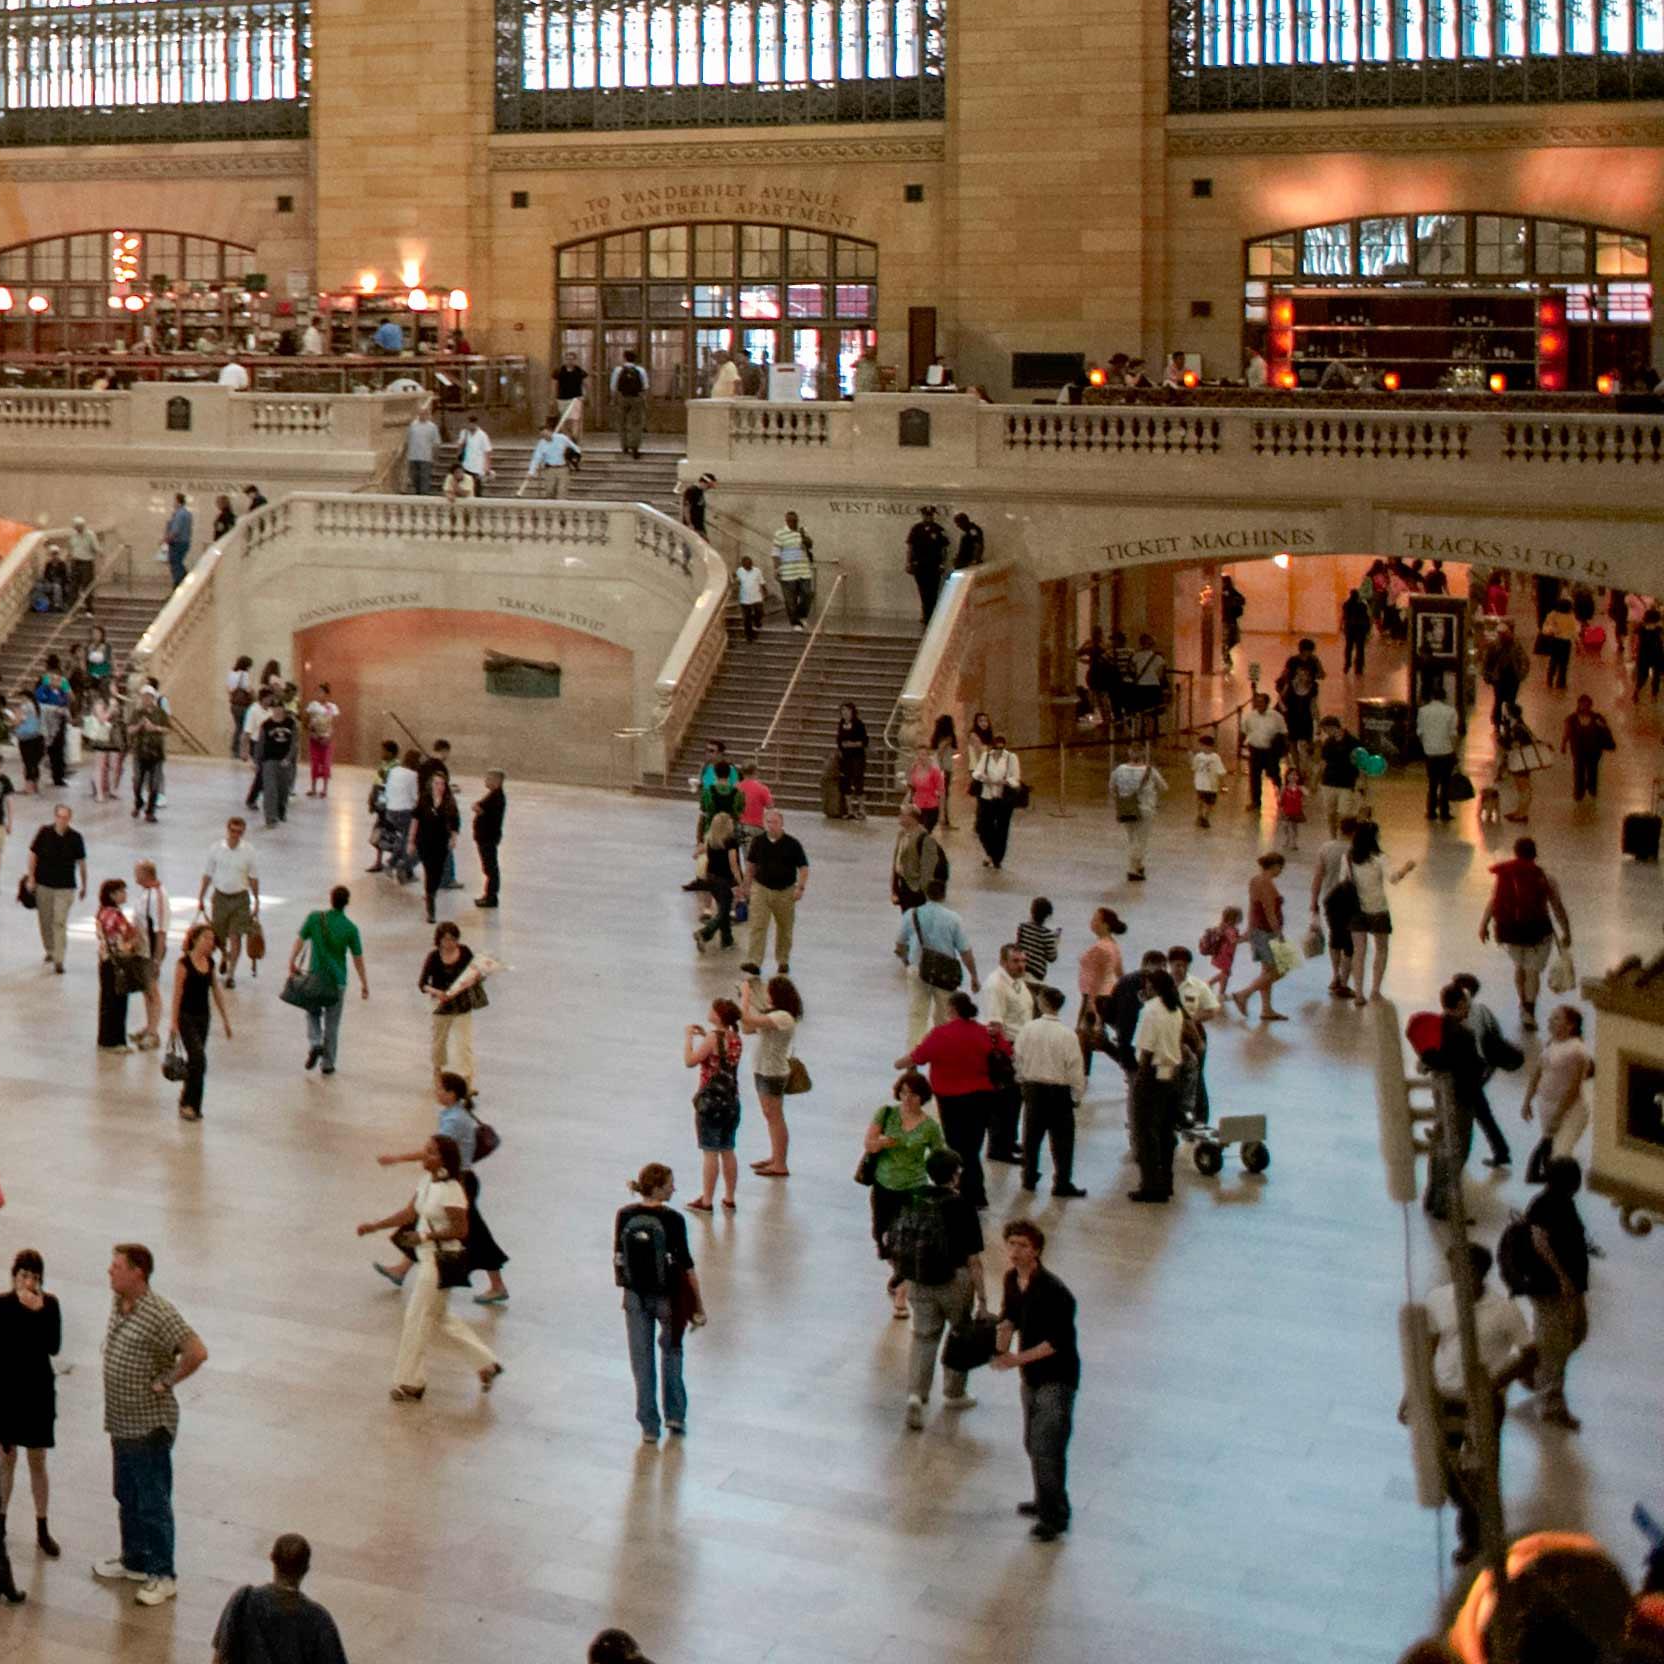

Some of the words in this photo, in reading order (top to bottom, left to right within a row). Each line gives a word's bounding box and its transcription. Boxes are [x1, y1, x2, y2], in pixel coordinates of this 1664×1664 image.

[586, 196, 610, 212] TO
[622, 184, 747, 204] VANDERBILT
[762, 186, 842, 208] AVENUE
[572, 215, 610, 233] THE
[621, 201, 722, 221] CAMPBELL
[736, 203, 857, 229] APARTMENT
[829, 501, 872, 514] WEST
[1100, 536, 1184, 561] TICKET
[1189, 527, 1316, 551] MACHINES
[1402, 532, 1503, 559] TRACKS
[1508, 545, 1531, 564] 31
[1541, 549, 1576, 572] TO
[1583, 558, 1609, 578] 42
